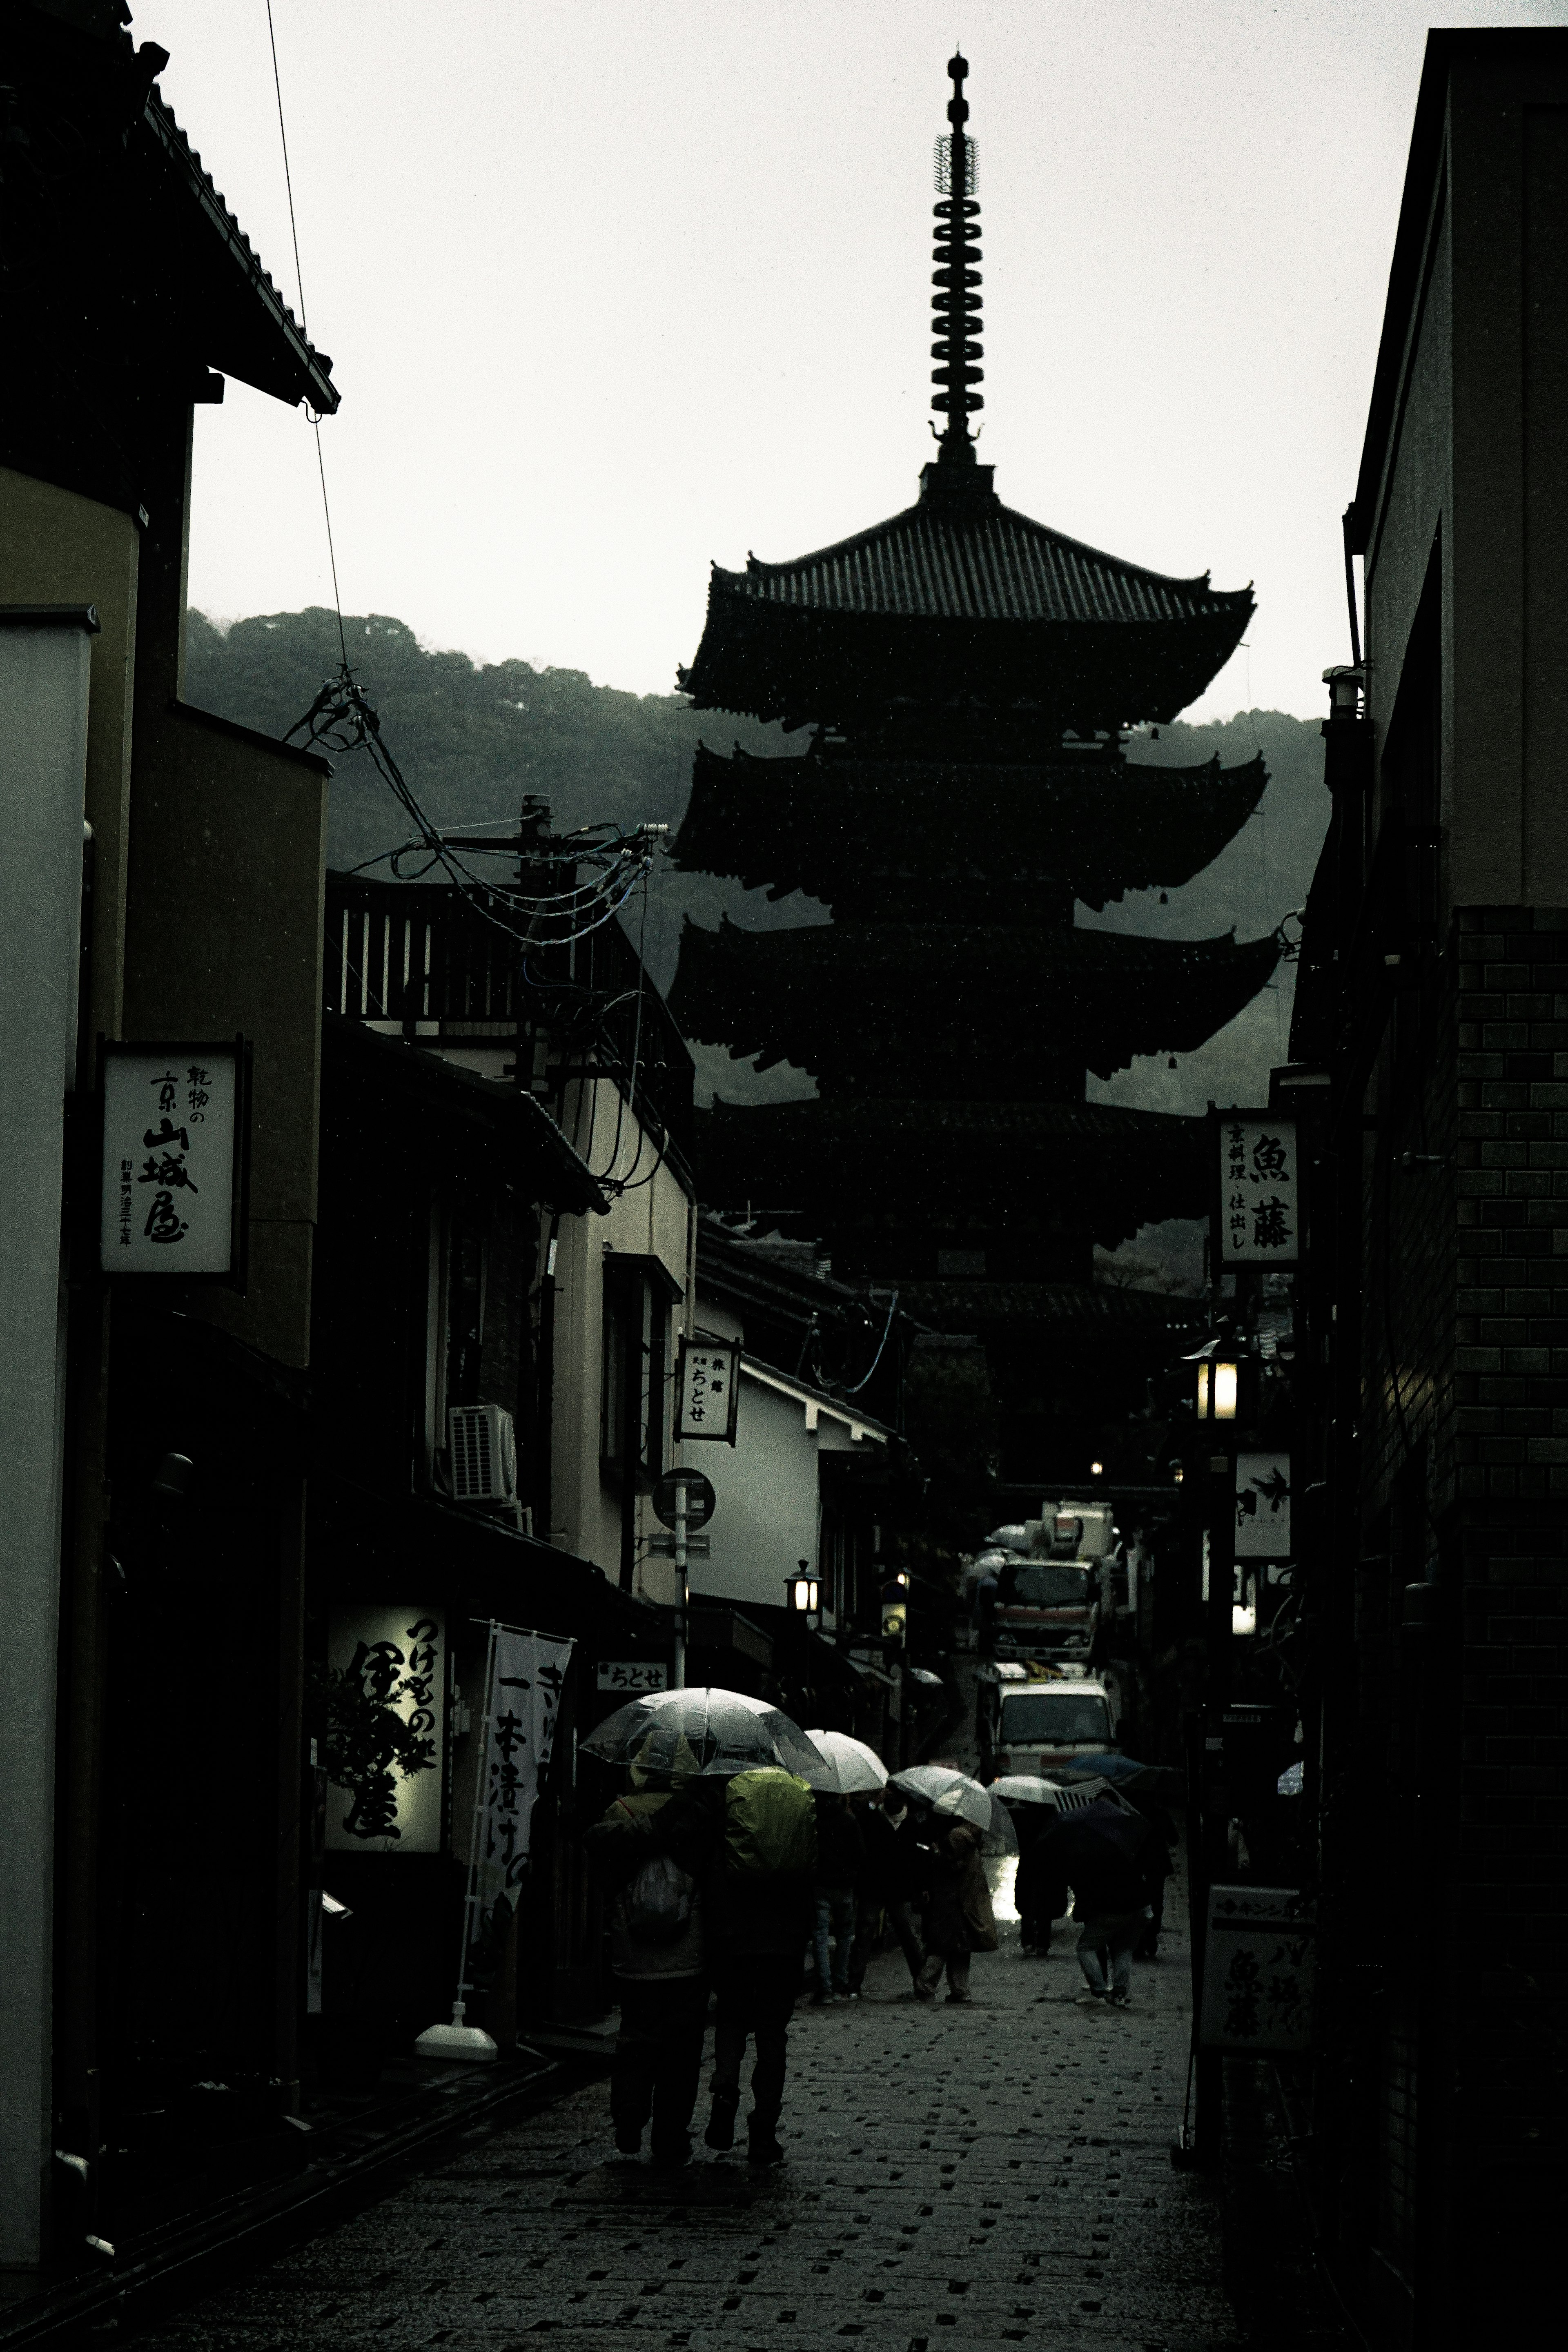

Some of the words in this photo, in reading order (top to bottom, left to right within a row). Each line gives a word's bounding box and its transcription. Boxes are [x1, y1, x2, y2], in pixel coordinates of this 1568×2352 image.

[187, 1066, 212, 1123] 乾物の
[120, 1159, 133, 1247] 創業明治三十七年
[1250, 1134, 1293, 1248] 魚藤
[689, 1369, 706, 1422] ちとせ
[711, 1358, 726, 1392] 旅館
[343, 1641, 405, 1839] 伊屋
[486, 1676, 530, 1865] 一本漬け
[1224, 1949, 1263, 2039] 魚藤
